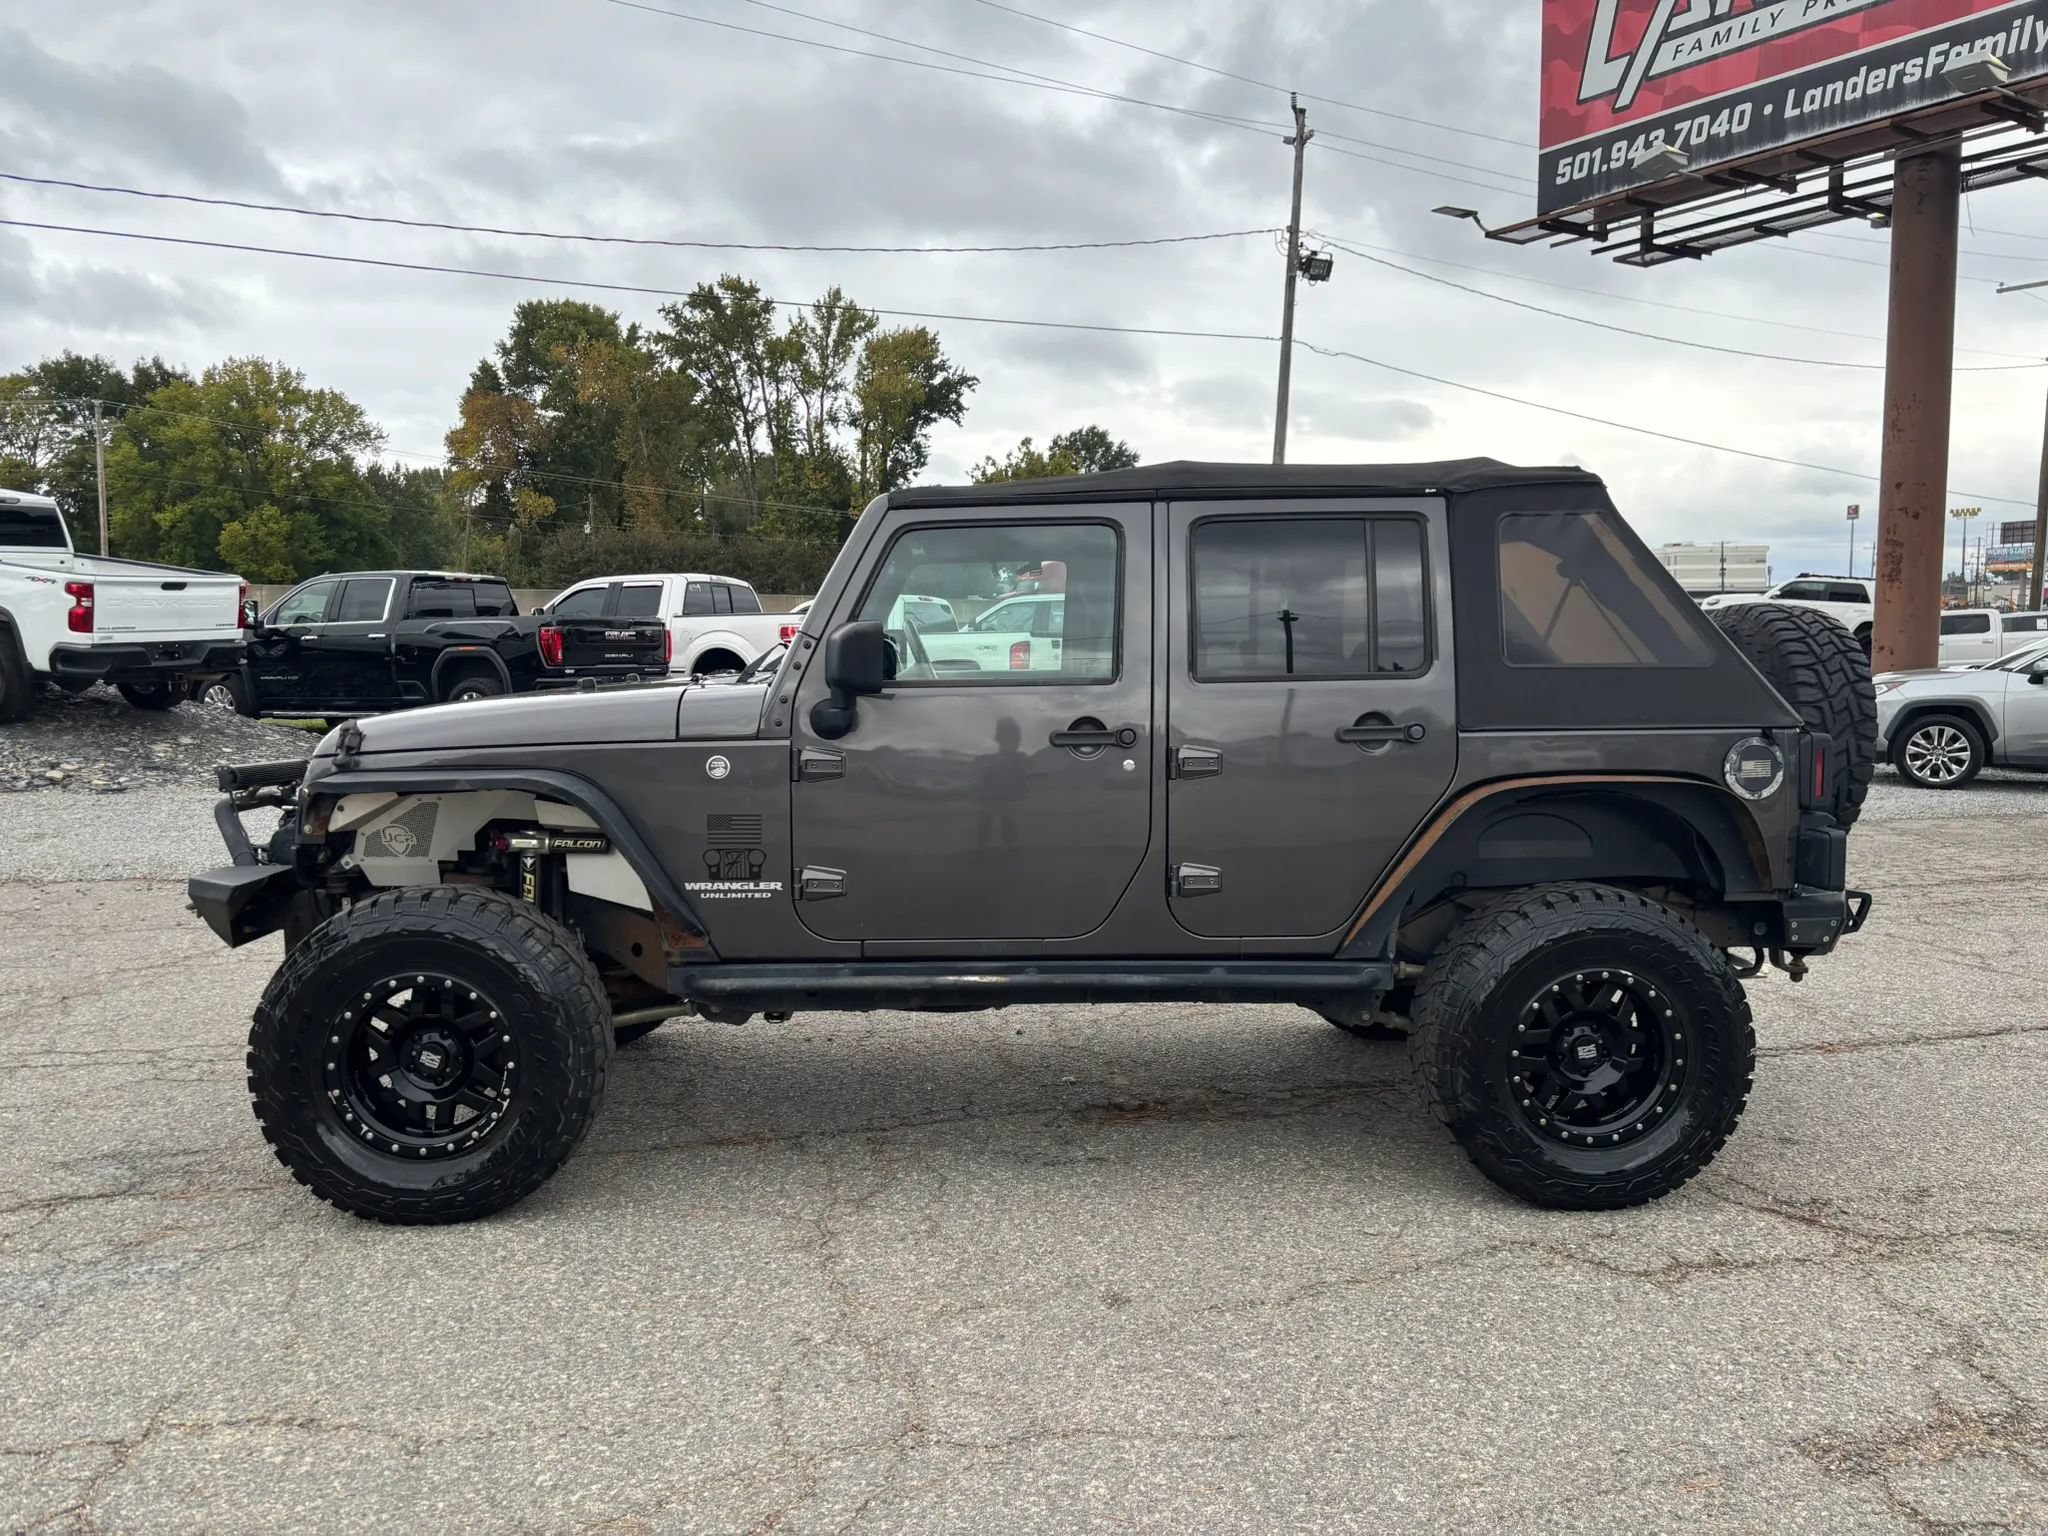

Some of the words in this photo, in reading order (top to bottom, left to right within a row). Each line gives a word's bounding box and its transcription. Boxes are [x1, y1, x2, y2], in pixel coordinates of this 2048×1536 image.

[1672, 8, 1785, 61] FAMILY
[1555, 102, 1752, 185] 501.9437040
[552, 839, 602, 849] FALCON
[684, 881, 784, 891] WRANGLER
